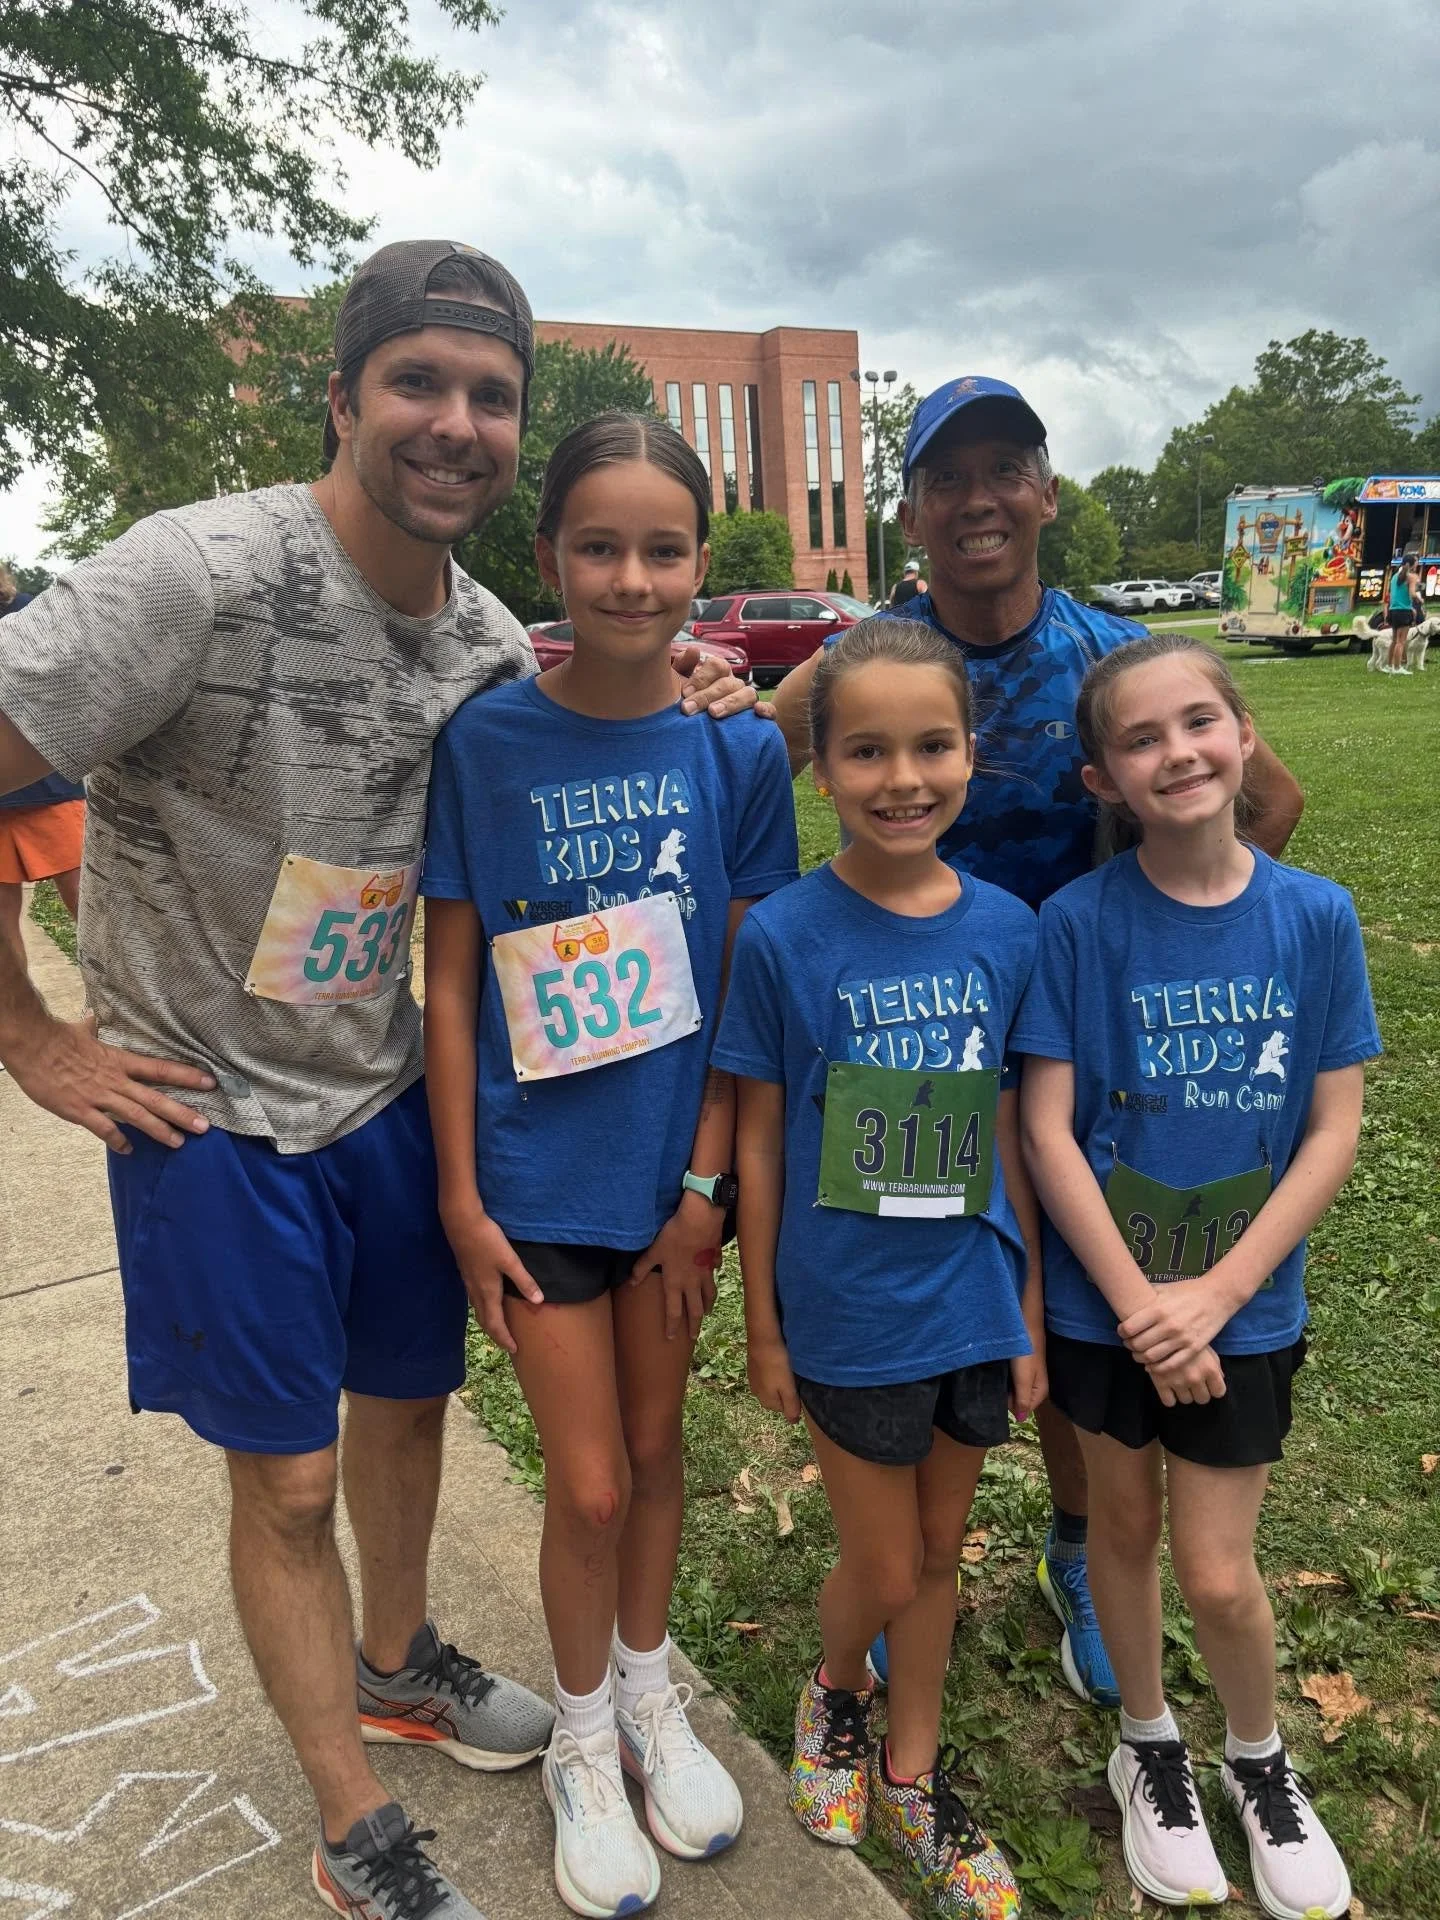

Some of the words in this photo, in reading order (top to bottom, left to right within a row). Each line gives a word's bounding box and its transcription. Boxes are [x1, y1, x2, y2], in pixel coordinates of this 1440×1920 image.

[530, 768, 692, 833] TERRA
[536, 825, 642, 884] KIDS
[303, 902, 408, 983] 533
[532, 948, 663, 1049] 532
[837, 967, 990, 1028] TERRA
[1131, 970, 1296, 1029] TERRA
[570, 1055, 591, 1066] TERRA
[592, 1047, 621, 1060] RUNNING
[621, 1038, 650, 1052] COMPANY
[847, 1022, 952, 1070] KIDS
[1136, 1027, 1245, 1078] KIDS
[1184, 1080, 1229, 1109] Run
[1236, 1085, 1286, 1112] Cam
[853, 1108, 981, 1179] 3114
[862, 1179, 966, 1195] WWW.TERRARUNNING.COM
